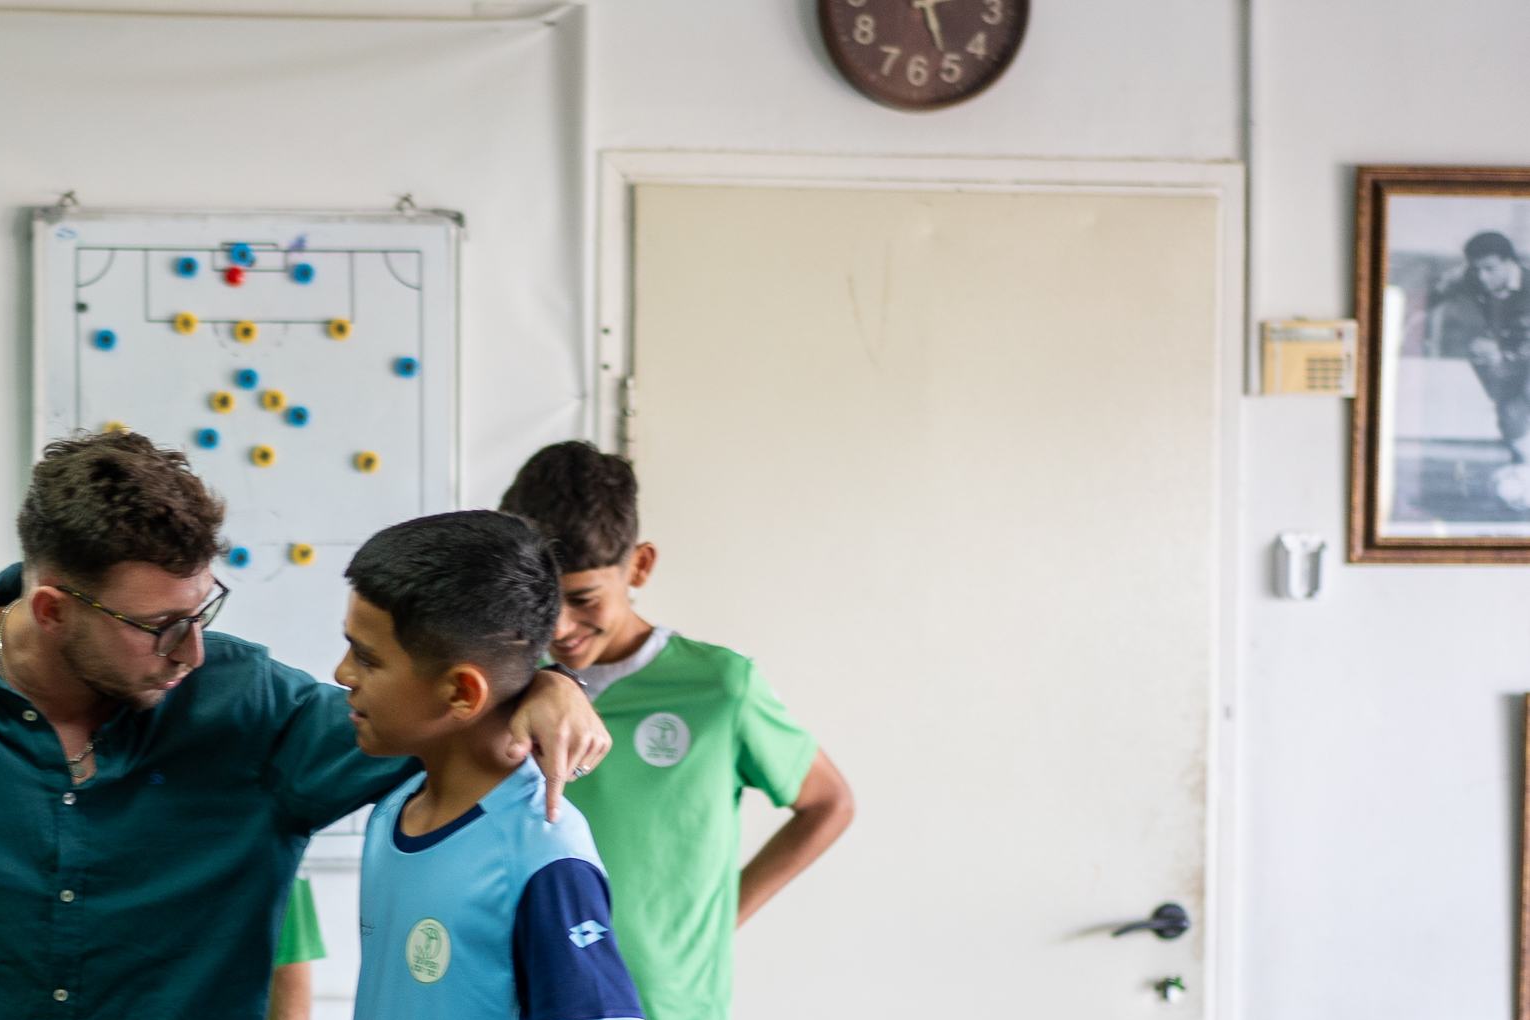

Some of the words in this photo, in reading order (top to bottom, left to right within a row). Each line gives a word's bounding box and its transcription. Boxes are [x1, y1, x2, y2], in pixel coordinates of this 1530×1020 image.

[982, 0, 1003, 25] 3
[854, 15, 875, 45] 8
[967, 32, 988, 60] 4
[880, 46, 901, 76] 7
[907, 57, 929, 87] 6
[940, 55, 963, 83] 5
